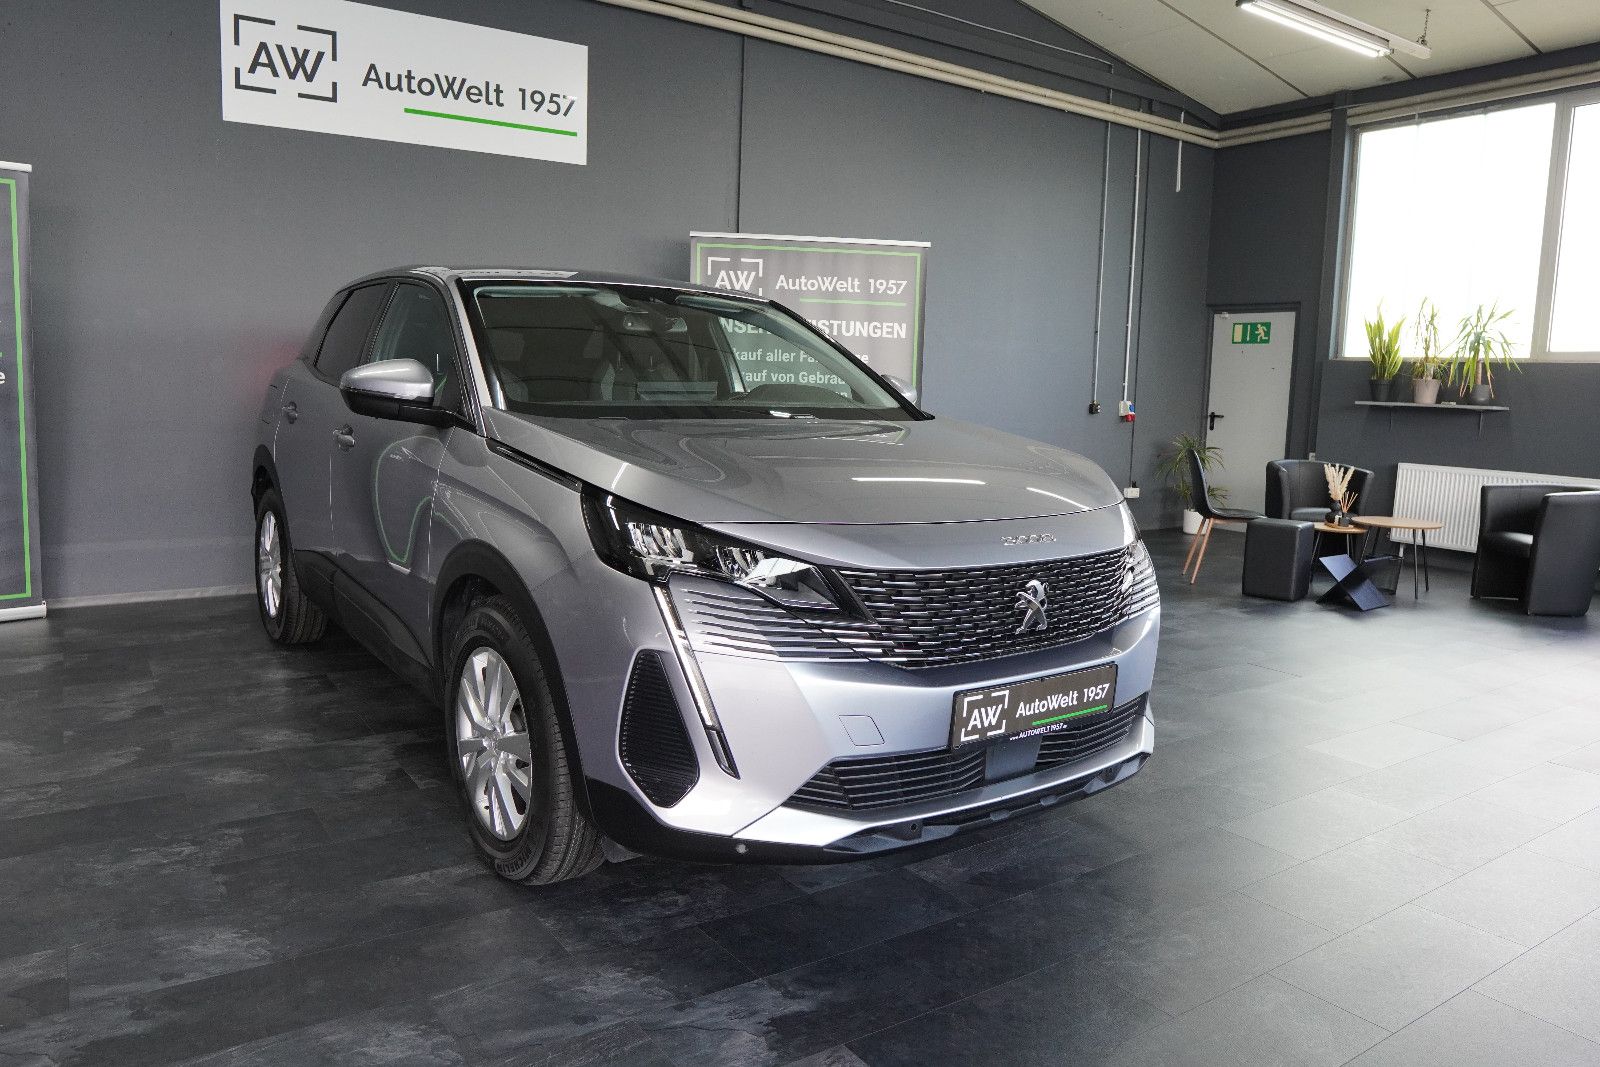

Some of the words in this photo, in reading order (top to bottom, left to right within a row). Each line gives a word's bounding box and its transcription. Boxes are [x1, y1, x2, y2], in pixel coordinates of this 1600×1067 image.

[248, 42, 325, 83] AW
[362, 63, 505, 108] AutoWelt
[518, 87, 577, 118] 1957
[714, 270, 756, 290] AW
[775, 274, 861, 293] AutoWelt
[868, 278, 908, 295] 1957
[805, 319, 907, 339] STUNGEN
[765, 349, 796, 362] aller
[742, 369, 768, 382] auf
[770, 372, 795, 383] von
[1015, 689, 1079, 718] AutoWelt
[1083, 683, 1110, 703] 1957
[967, 703, 1003, 731] AW
